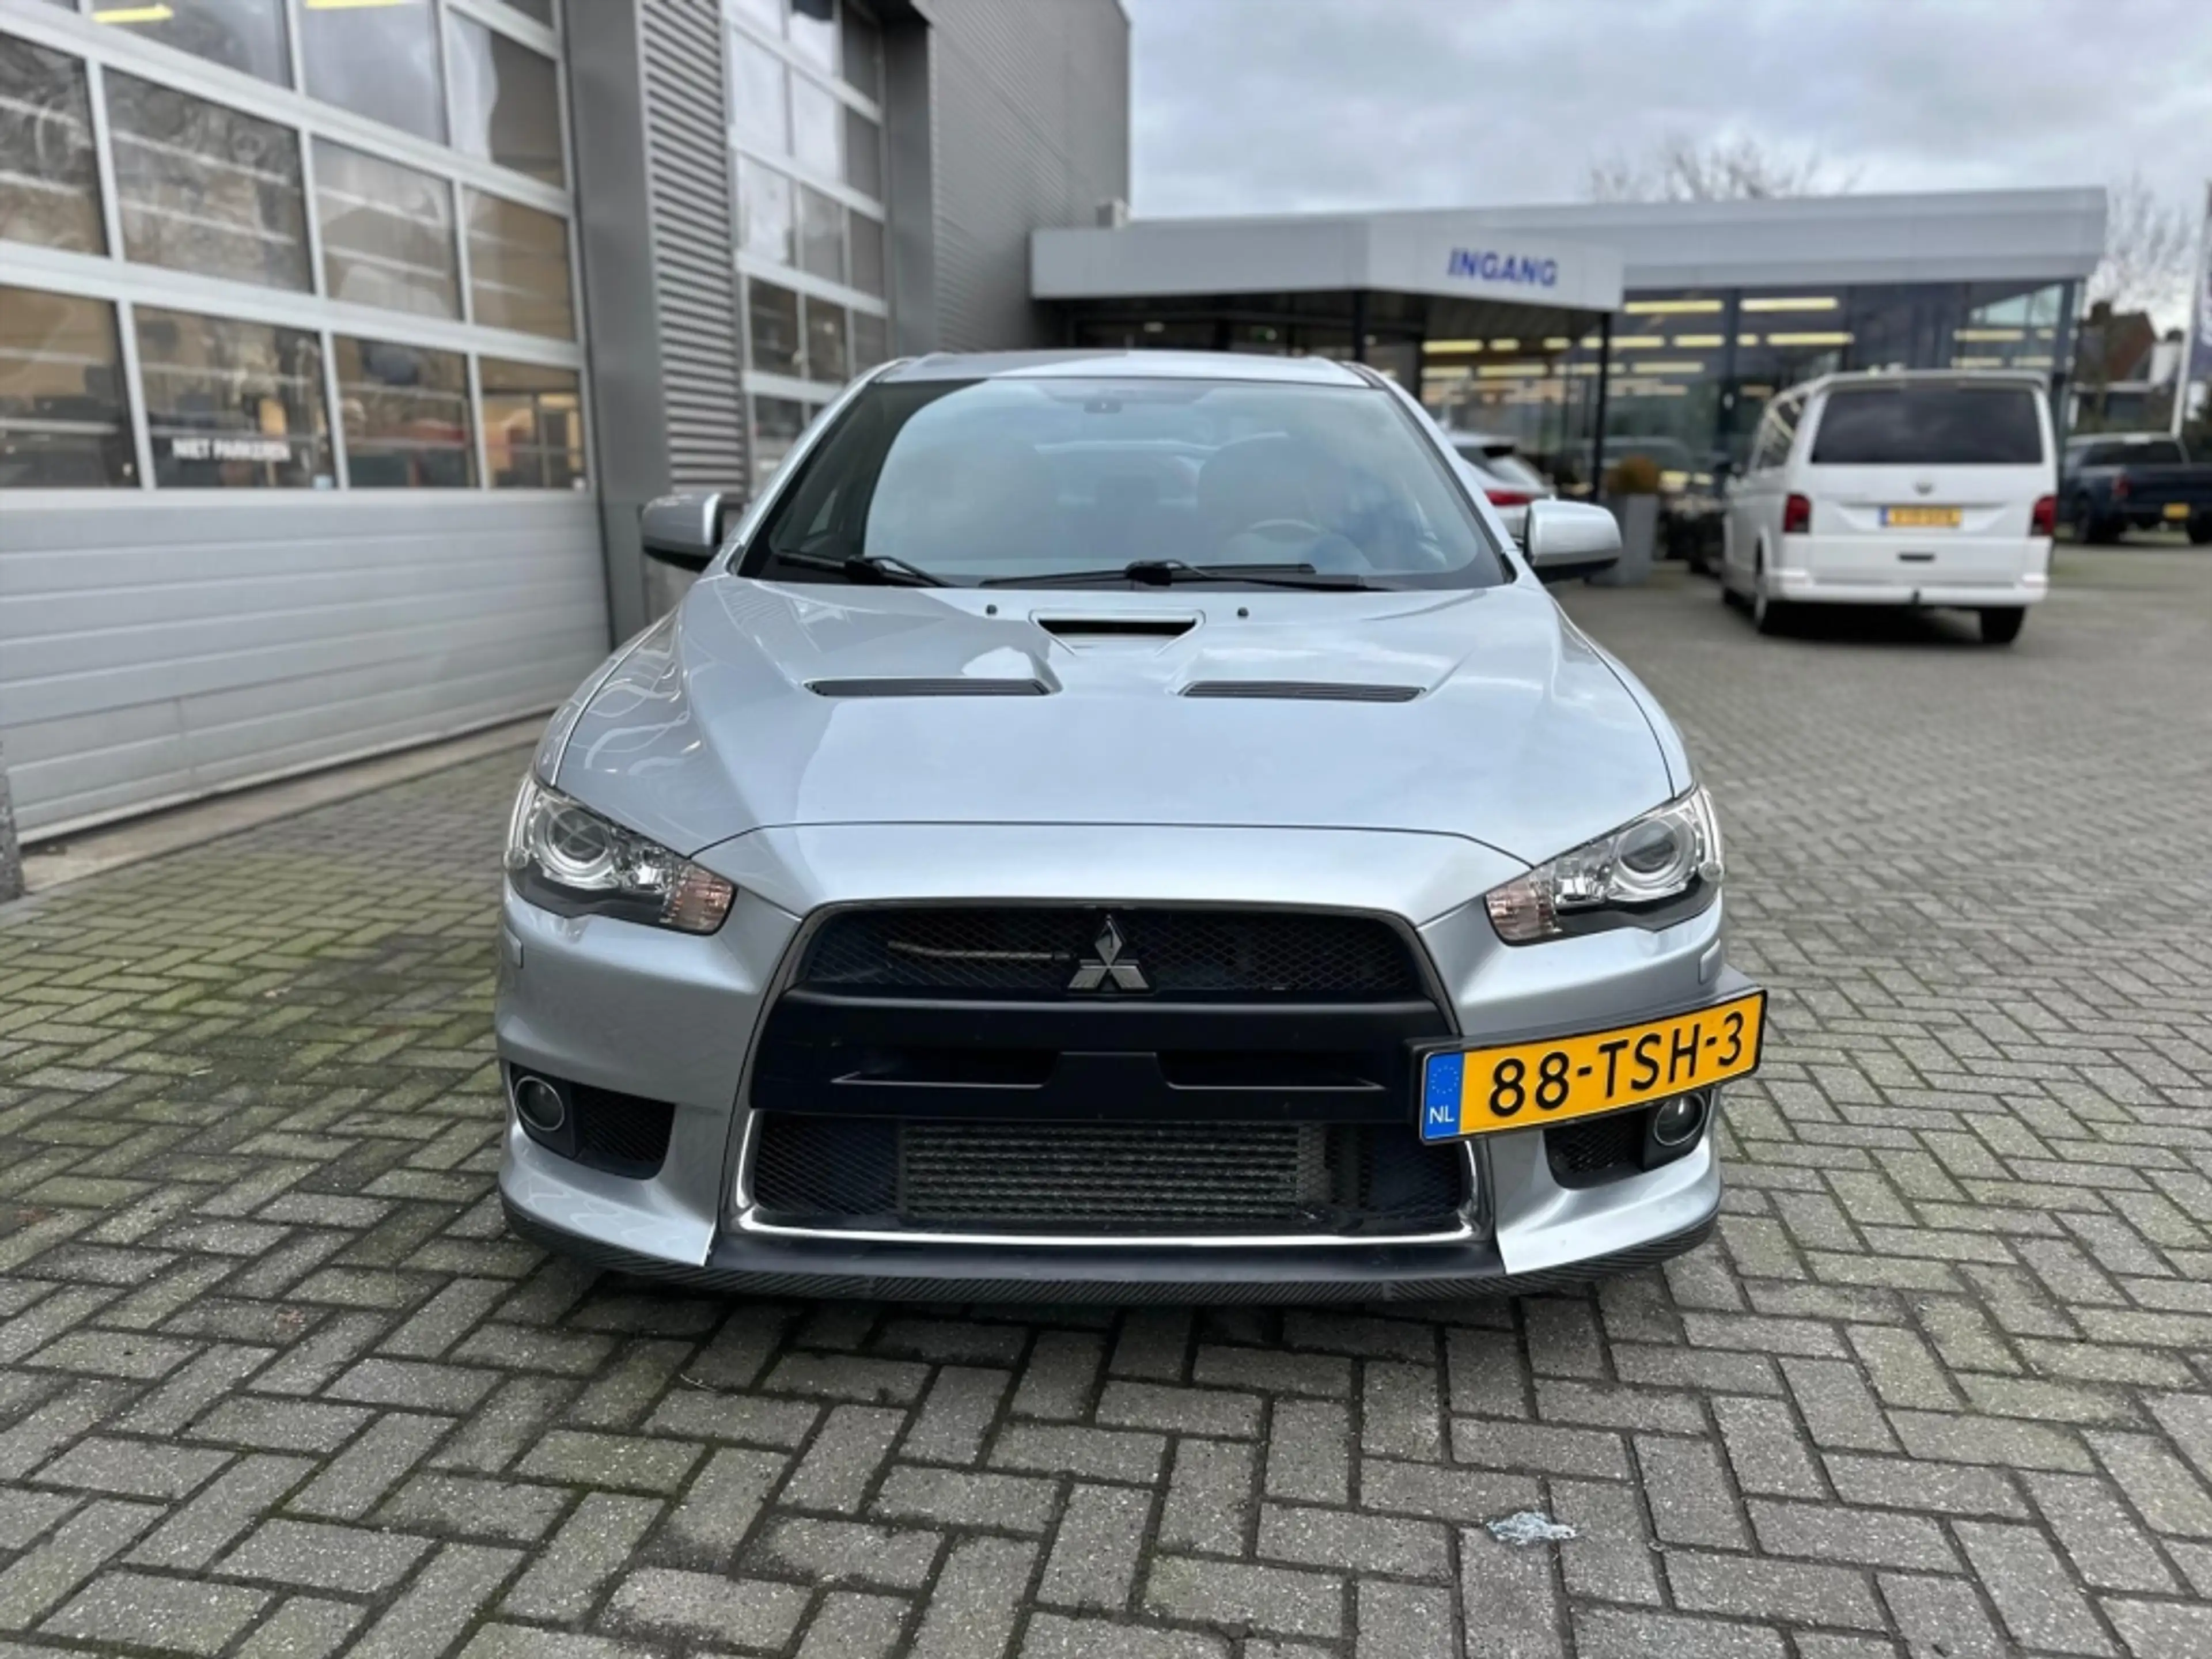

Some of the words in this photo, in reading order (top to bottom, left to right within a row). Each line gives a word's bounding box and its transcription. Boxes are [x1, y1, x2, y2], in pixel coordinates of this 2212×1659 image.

[1448, 248, 1558, 287] INGANG
[1488, 1010, 1744, 1118] 88-TSH-3
[1429, 1105, 1455, 1124] NL
